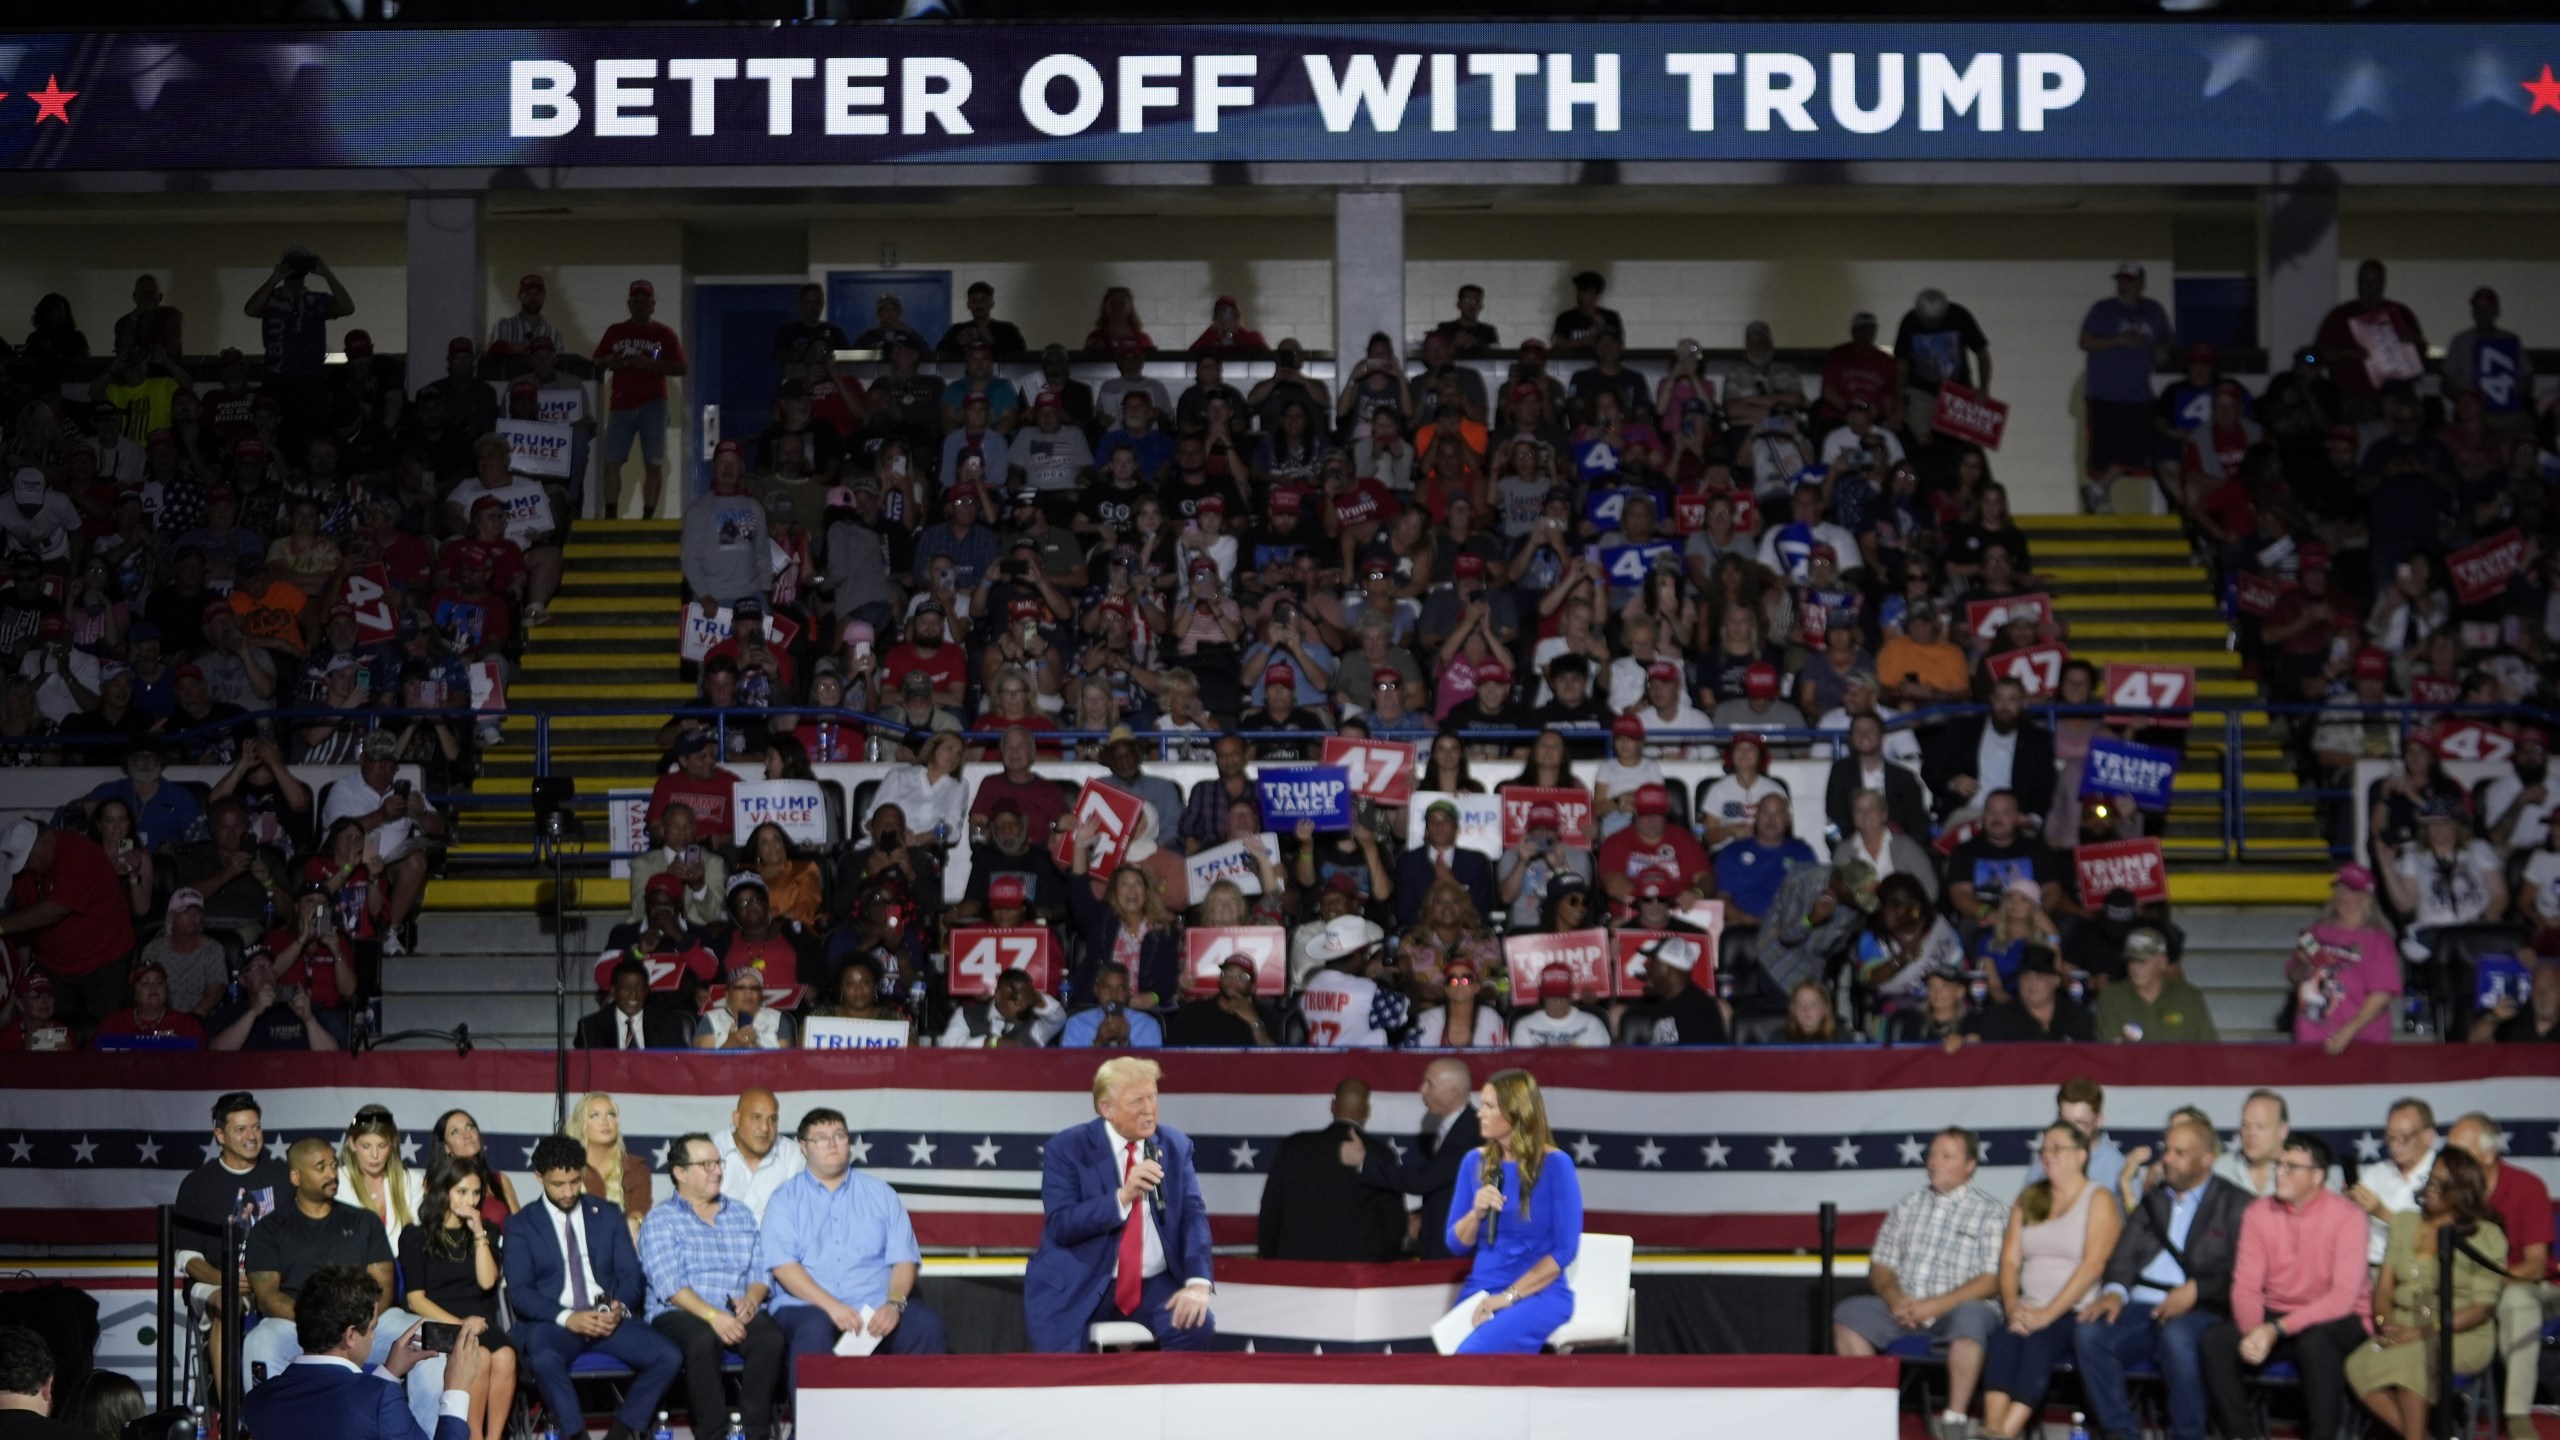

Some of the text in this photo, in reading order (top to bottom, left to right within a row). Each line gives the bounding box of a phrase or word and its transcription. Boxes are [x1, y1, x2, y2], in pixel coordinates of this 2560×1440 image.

[510, 52, 2084, 137] BETTER OFF WITH TRUMP
[613, 338, 633, 353] RED
[2480, 346, 2515, 405] 47
[216, 399, 253, 410] PROUD
[220, 408, 250, 417] TO BE
[538, 401, 577, 412] UMP
[1944, 393, 2004, 425] TRUMP
[2183, 394, 2213, 423] 4
[538, 410, 570, 420] NCE
[501, 431, 568, 449] TRUMP
[510, 445, 560, 459] VANCE
[1584, 442, 1618, 471] 4
[504, 494, 542, 511] UMP
[1099, 500, 1131, 520] GO
[1181, 499, 1196, 515] G
[1336, 499, 1378, 520] Trump
[1681, 500, 1750, 518] TRP
[506, 506, 539, 521] NCE
[346, 575, 394, 634] 47
[693, 617, 733, 634] TRU
[2008, 648, 2062, 695] 47
[2113, 671, 2185, 709] 47
[1333, 746, 1405, 794] 47
[2091, 749, 2173, 777] TRUMP
[2097, 767, 2163, 791] VANCE
[1263, 780, 1345, 799] TRUMP
[741, 796, 819, 813] TRUMP
[1273, 796, 1336, 811] VANCE
[1506, 800, 1588, 818] TRMP
[751, 810, 812, 823] VANCE
[2081, 852, 2159, 879] TRUMP
[2090, 869, 2153, 889] VANCE
[959, 936, 1038, 984] 47
[1196, 936, 1274, 977] 47
[1514, 946, 1602, 967] TRUMP
[1304, 991, 1350, 1013] TRUMP
[270, 1024, 302, 1034] TRUMP
[813, 1035, 900, 1048] TRUMP
